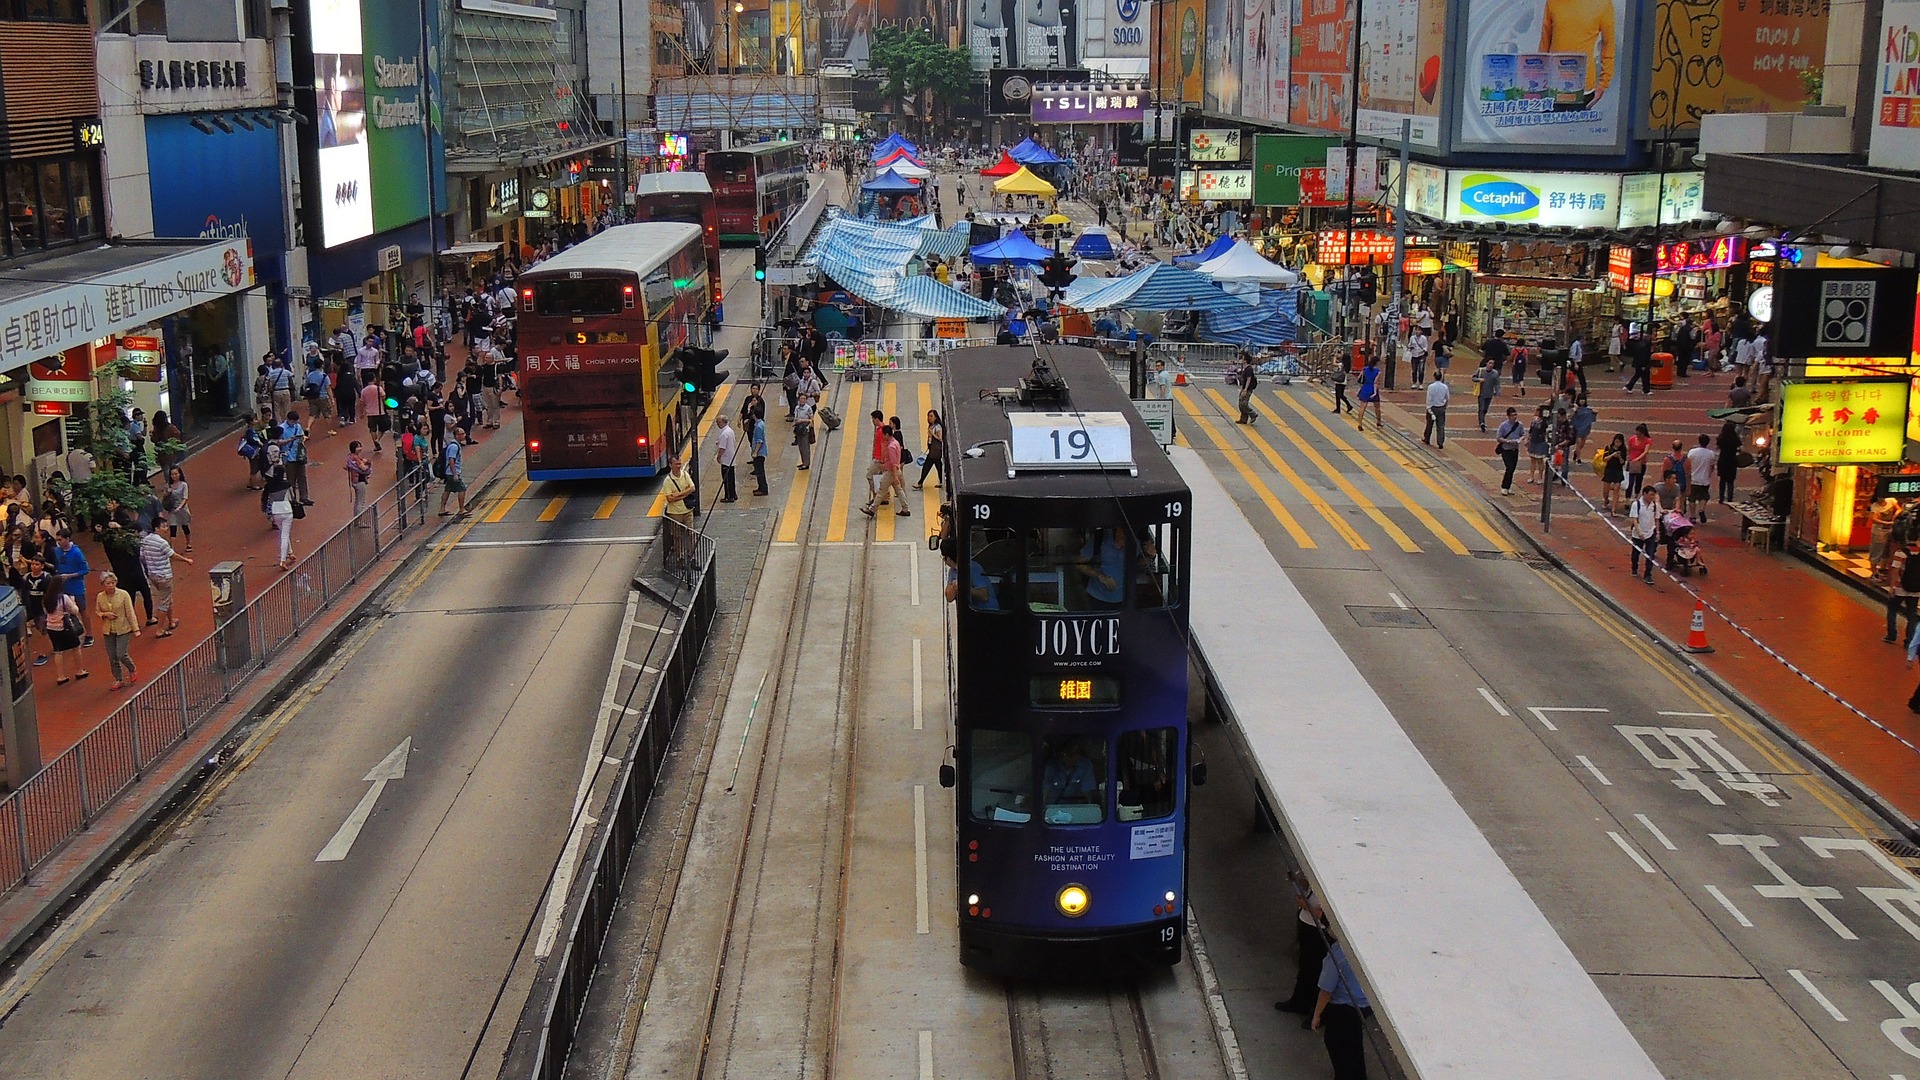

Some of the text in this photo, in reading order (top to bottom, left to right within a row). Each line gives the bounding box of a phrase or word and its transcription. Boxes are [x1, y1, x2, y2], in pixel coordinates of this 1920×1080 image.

[972, 38, 986, 47] SOGO
[1027, 37, 1042, 46] SOGO
[1113, 27, 1144, 45] SOGO
[1886, 25, 1920, 63] KiD
[972, 46, 1000, 56] NEW STORE
[1027, 46, 1057, 56] NEW STORE
[374, 55, 418, 88] Standard
[1883, 65, 1920, 95] LAN
[1042, 96, 1139, 110] TSL 謝瑞麟
[373, 95, 420, 129] Chartered
[89, 124, 103, 145] 24
[1473, 190, 1606, 211] Cetaphil 舒特膚
[1826, 283, 1872, 298] 眼鏡88
[0, 267, 217, 362] 卓理財中心 進駐 Times Square
[576, 331, 587, 344] 5
[126, 352, 154, 363] Jetco
[525, 354, 581, 371] 周大福
[31, 387, 84, 396] BEA 東亞銀行
[1809, 390, 1883, 402] 환영합니다
[1807, 407, 1881, 425] 美珍香
[1814, 427, 1872, 437] welcome
[1050, 429, 1091, 460] 19
[1795, 449, 1814, 457] BEE
[1856, 448, 1888, 456] HIANG
[972, 504, 991, 520] 19
[1164, 501, 1183, 518] 19
[1035, 618, 1120, 656] JOYCE
[1060, 680, 1092, 700] 維園
[1034, 853, 1116, 862] FASHION ART BEAUTY
[1050, 845, 1100, 854] THE ULTIMATE
[1051, 863, 1099, 871] DESTINATION
[1160, 926, 1175, 942] 19
